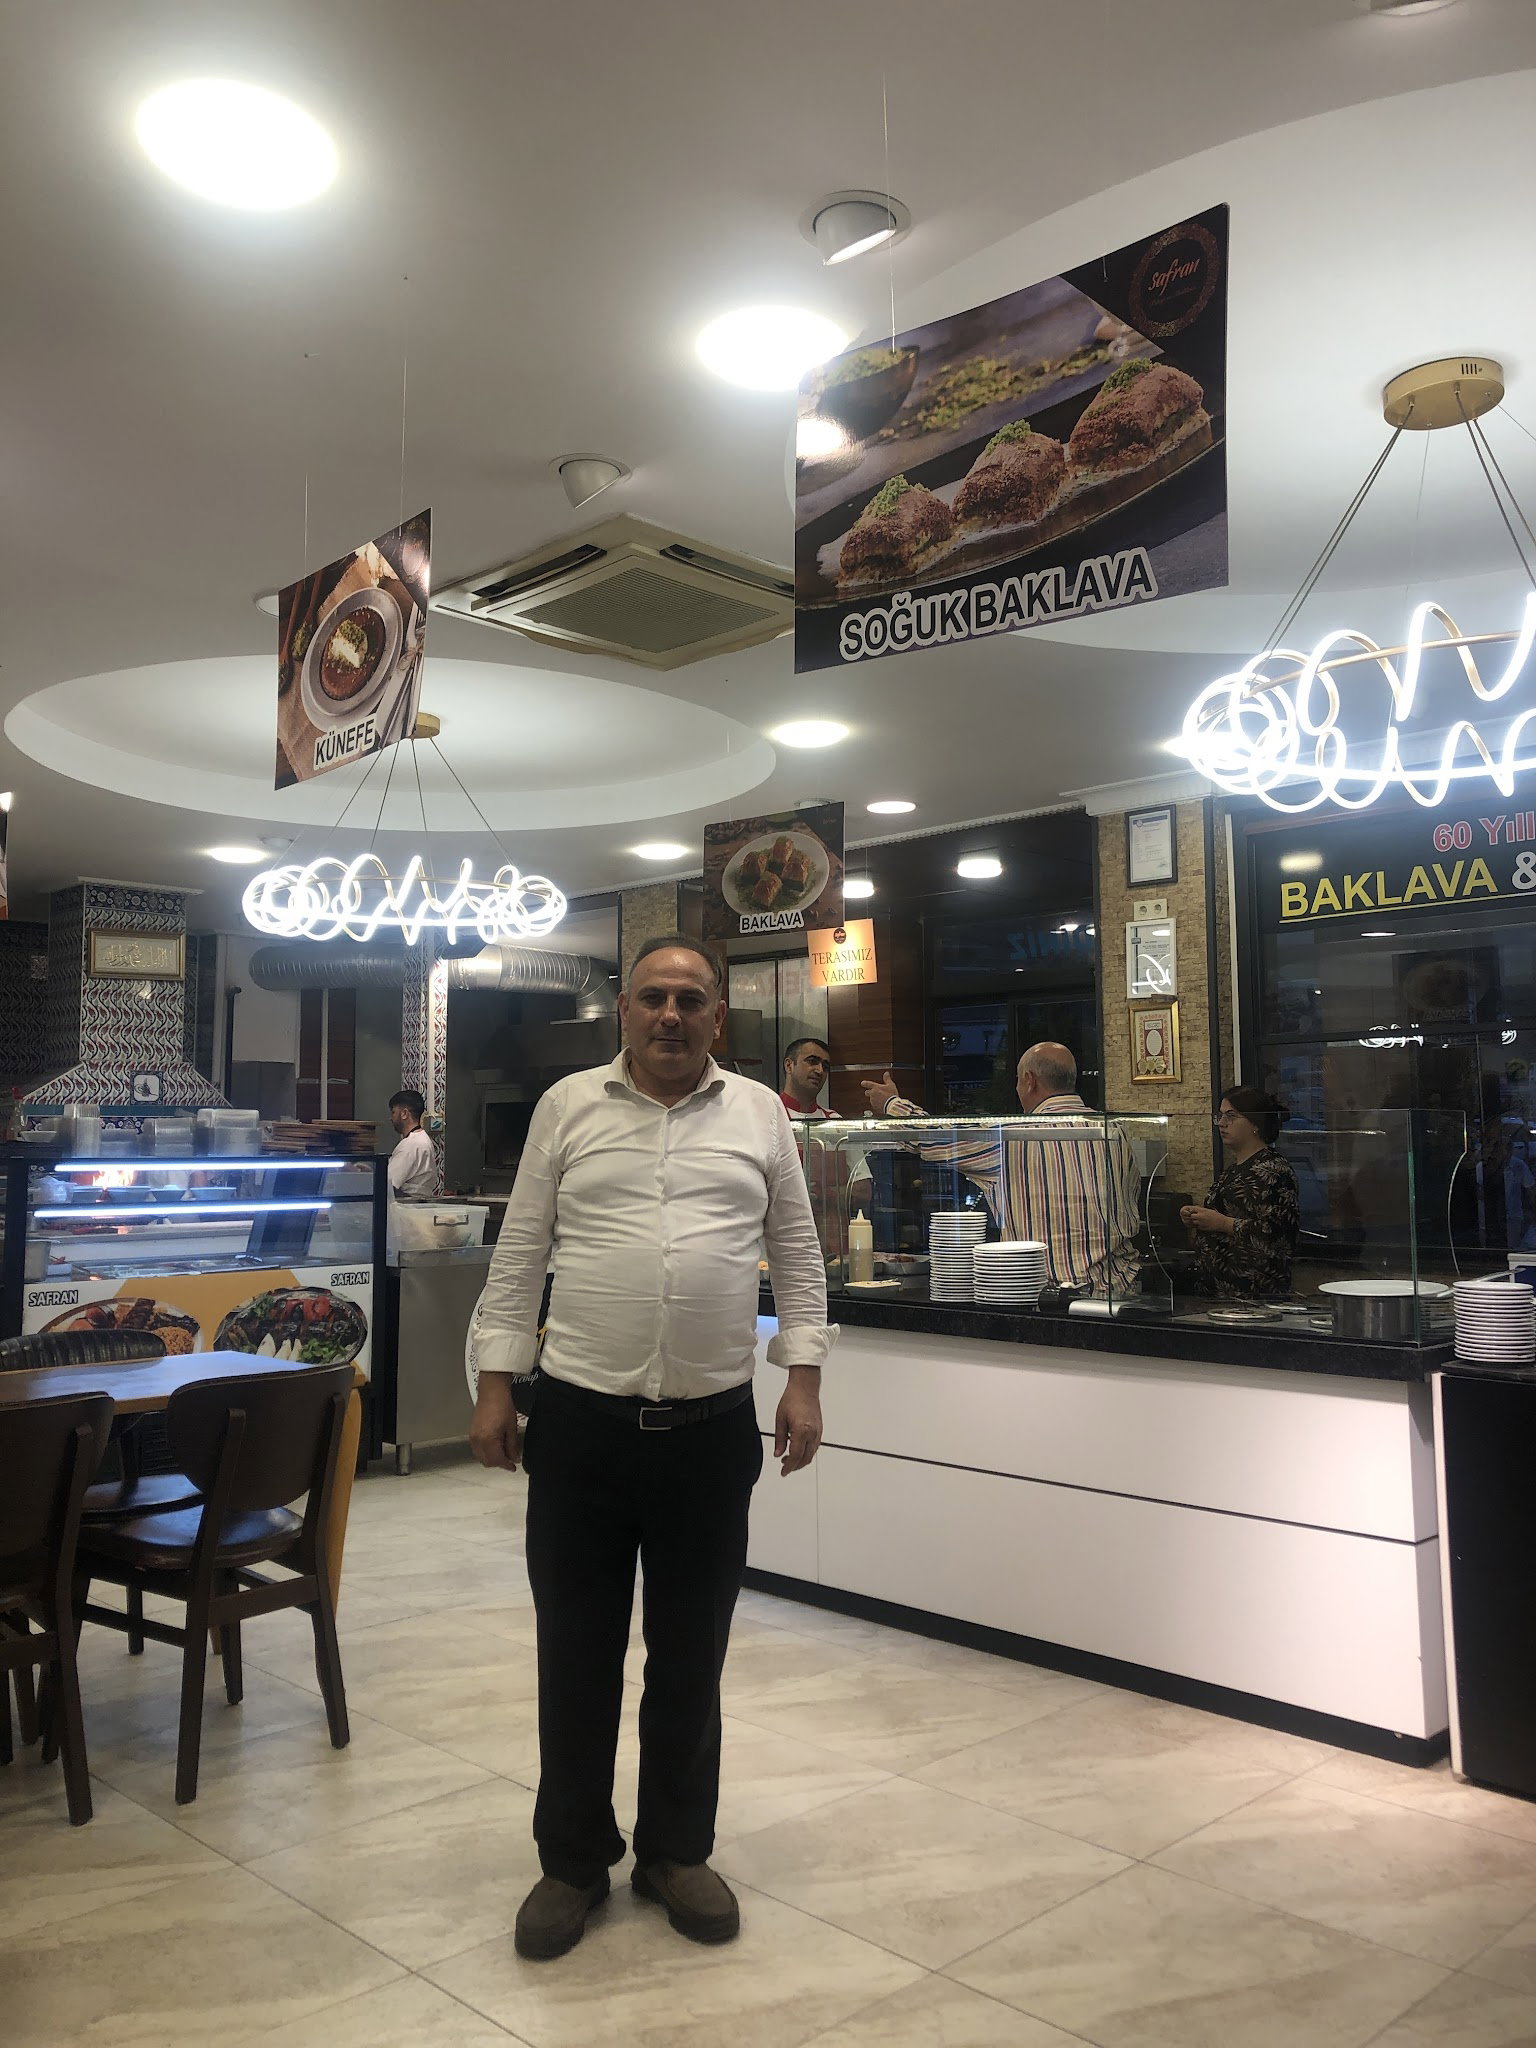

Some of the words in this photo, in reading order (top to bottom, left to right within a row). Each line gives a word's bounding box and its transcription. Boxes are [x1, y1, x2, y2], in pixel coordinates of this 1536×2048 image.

[1148, 258, 1200, 296] safran
[841, 589, 969, 660] SOĞUK
[973, 548, 1157, 634] BAKLAVA
[314, 716, 377, 768] KÜNEFE
[1432, 820, 1473, 853] 60
[1280, 857, 1499, 918] BAKLAVA
[741, 911, 804, 932] BAKLAVA
[821, 967, 866, 984] VARDIR
[331, 1271, 370, 1287] SAFRAN
[28, 1289, 79, 1307] SAFRAN
